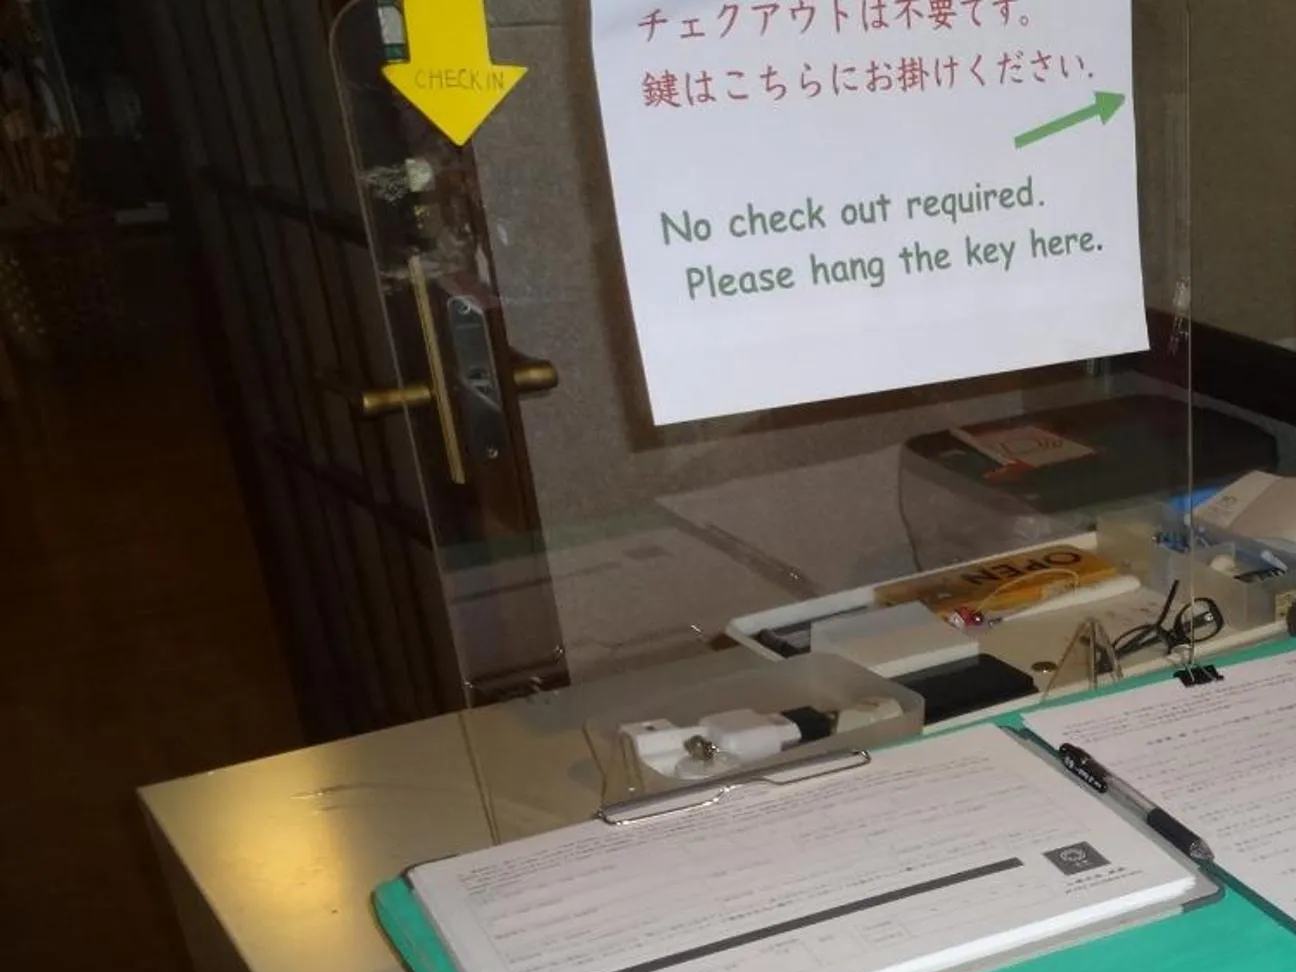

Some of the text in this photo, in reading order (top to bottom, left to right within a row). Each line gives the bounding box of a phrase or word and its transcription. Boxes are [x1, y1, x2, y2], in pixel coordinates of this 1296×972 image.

[413, 68, 504, 91] CHECK IN
[660, 175, 1045, 246] No check out required.
[685, 228, 1104, 300] Please hang the key here.
[960, 551, 1083, 587] OPEN
